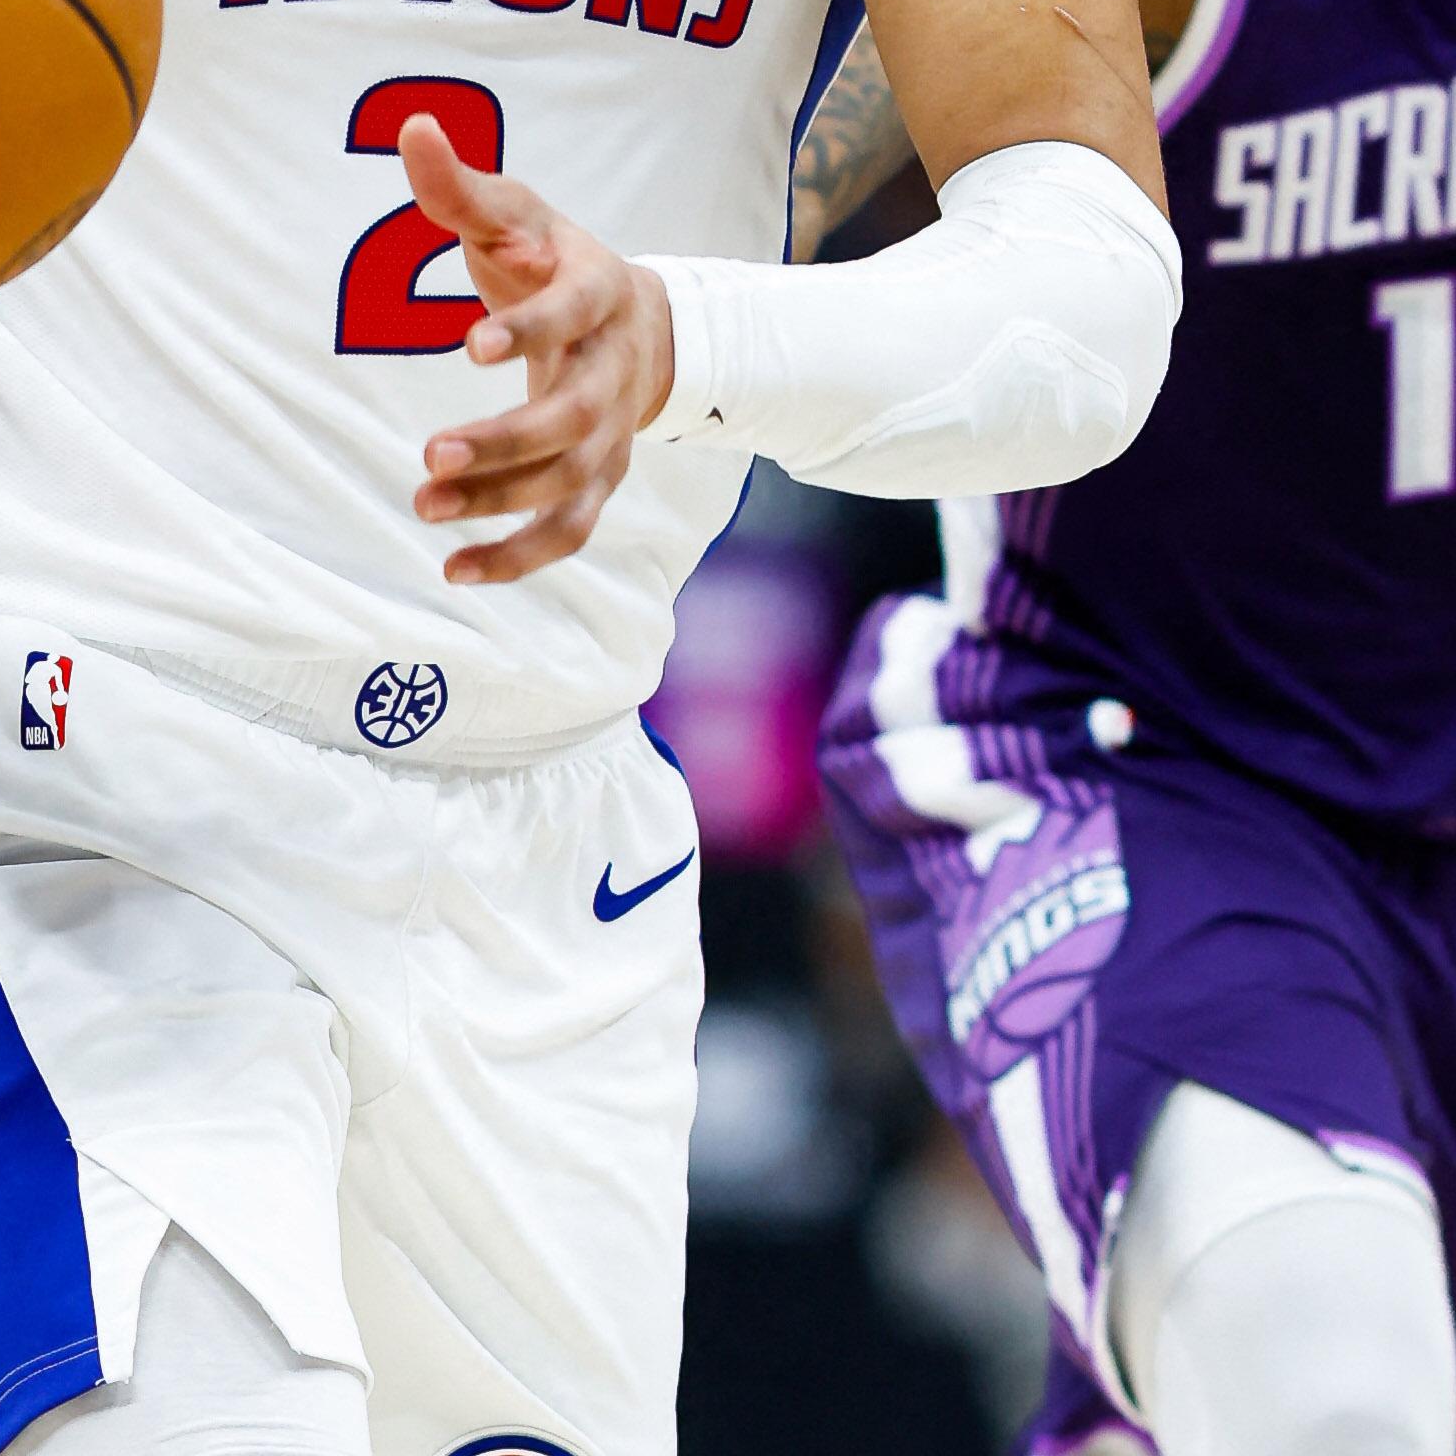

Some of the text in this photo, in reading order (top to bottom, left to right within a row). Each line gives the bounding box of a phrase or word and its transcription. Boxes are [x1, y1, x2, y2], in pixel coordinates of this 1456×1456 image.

[335, 75, 504, 355] 2
[25, 726, 49, 745] NBA
[948, 864, 1131, 1044] KINGS
